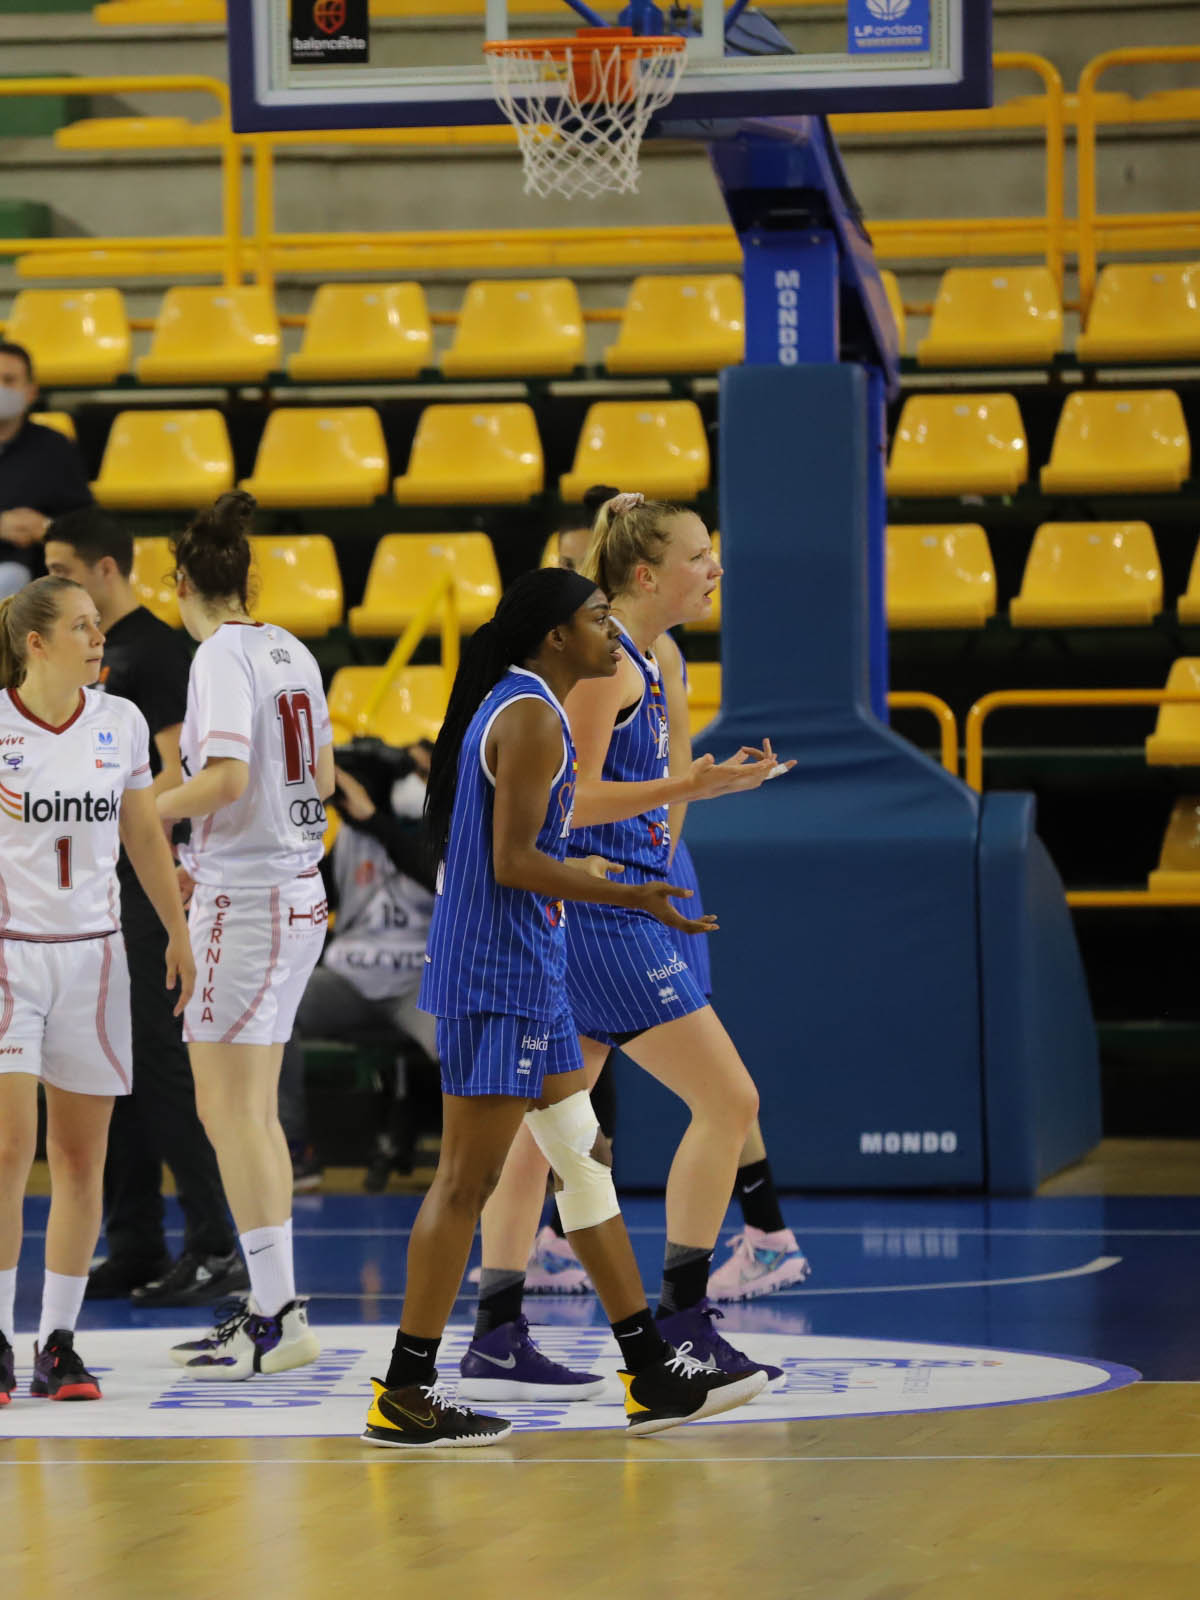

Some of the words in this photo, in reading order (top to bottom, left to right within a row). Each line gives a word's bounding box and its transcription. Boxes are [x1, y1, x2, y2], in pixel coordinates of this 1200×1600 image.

[775, 269, 800, 366] MONDO
[275, 689, 316, 786] 10
[24, 790, 120, 823] lointek
[54, 836, 73, 890] 1
[201, 894, 232, 1024] GERNIKA
[860, 1132, 958, 1154] MONDO
